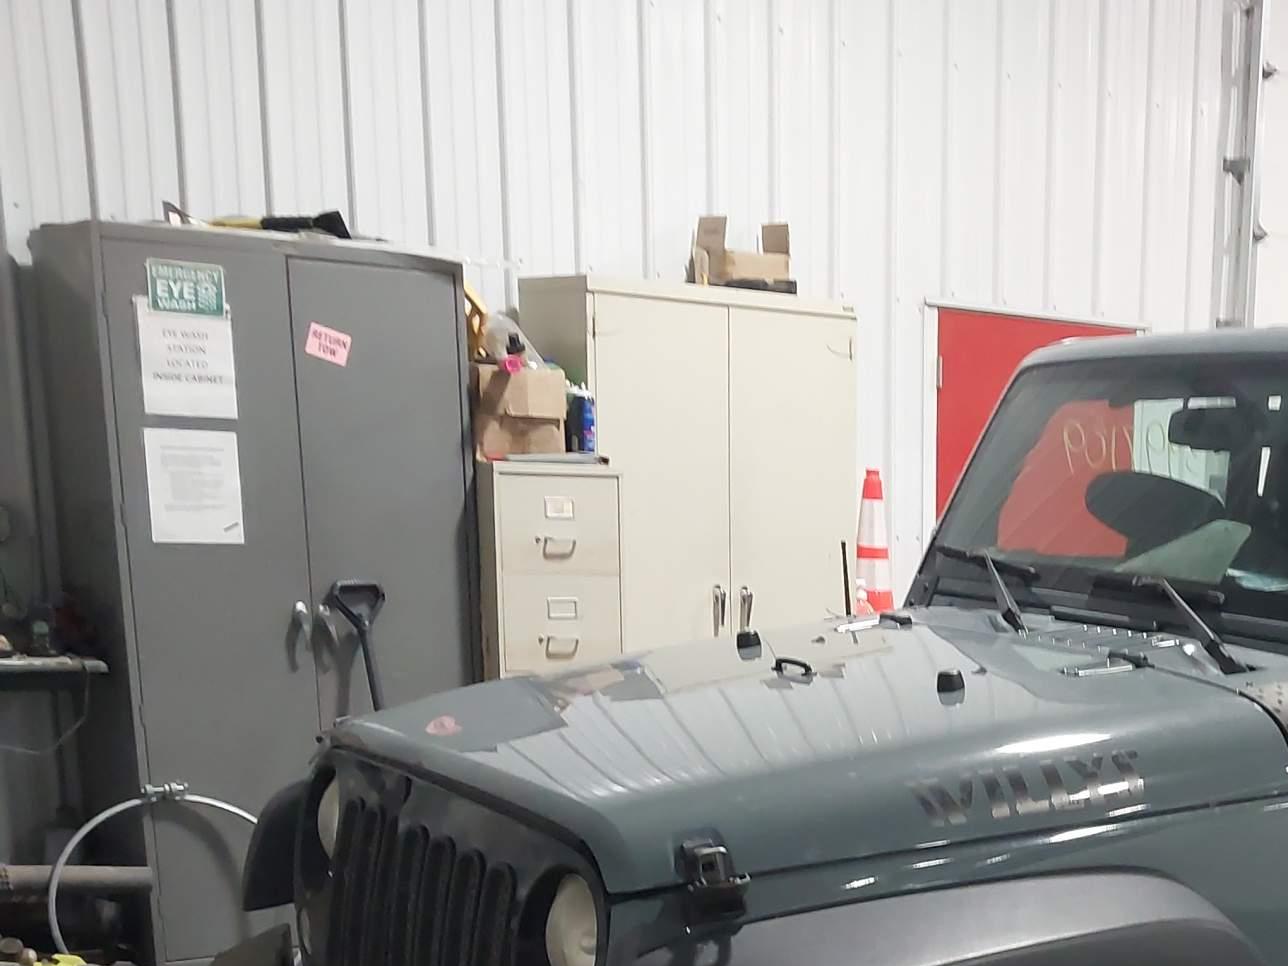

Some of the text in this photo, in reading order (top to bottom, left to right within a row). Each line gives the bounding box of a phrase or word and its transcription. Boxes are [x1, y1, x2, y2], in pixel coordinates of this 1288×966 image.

[151, 264, 219, 283] EMERGENCY
[156, 279, 196, 300] EYE
[157, 297, 197, 311] WASH
[167, 344, 206, 354] STATION
[311, 329, 348, 350] RETURN
[183, 375, 224, 384] CABINET
[912, 751, 1143, 826] WILLYS
